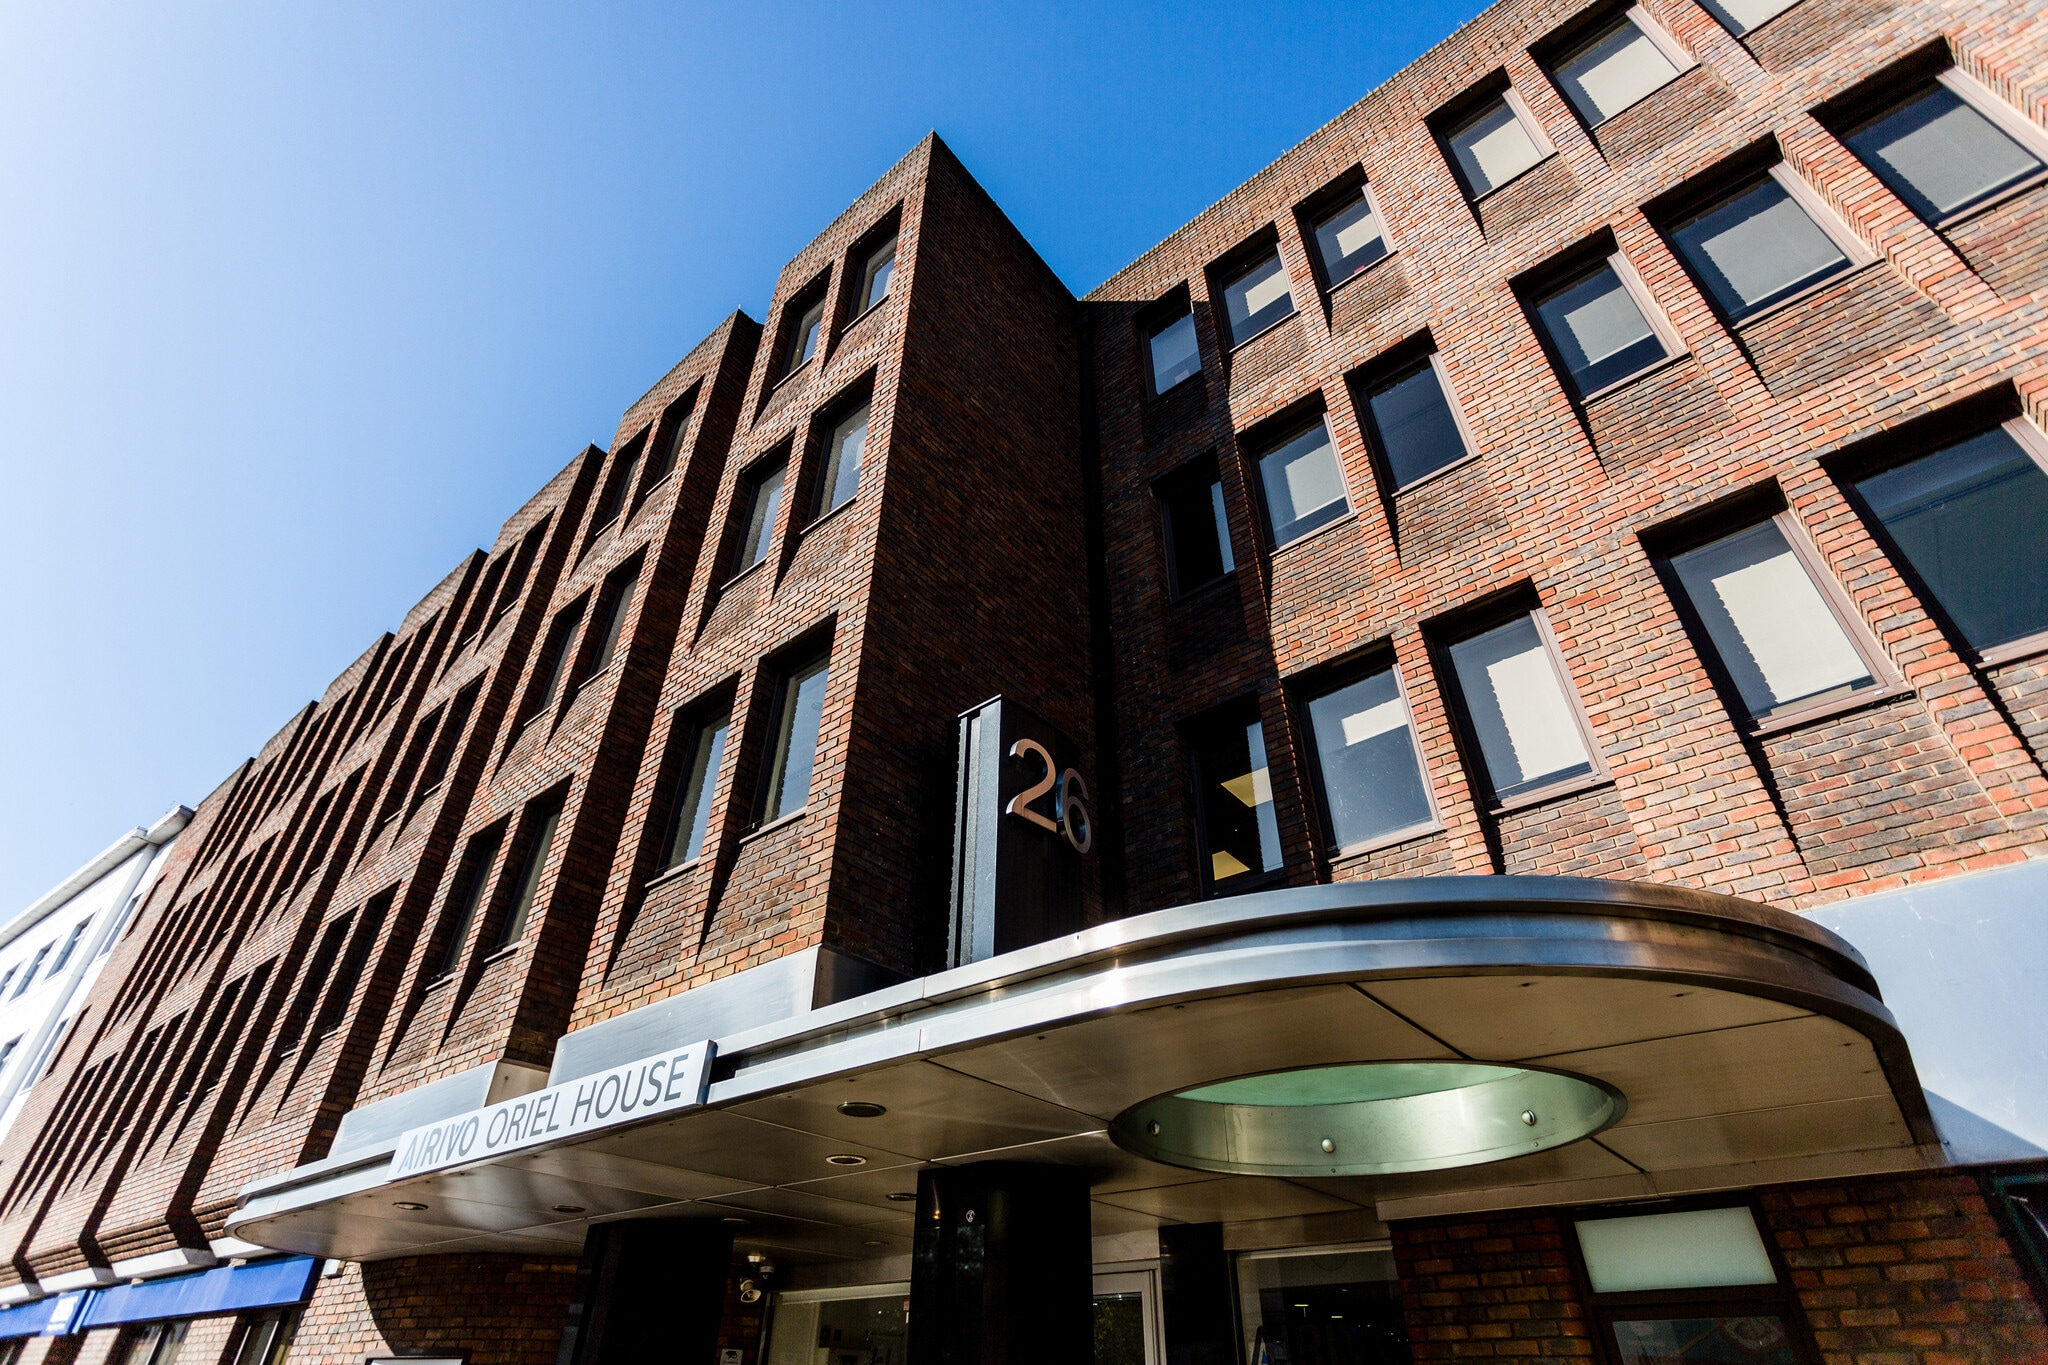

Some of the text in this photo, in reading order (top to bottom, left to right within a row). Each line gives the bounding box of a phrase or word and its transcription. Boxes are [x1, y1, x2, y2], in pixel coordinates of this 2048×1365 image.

[1006, 738, 1092, 853] 26
[398, 1054, 690, 1174] AIRIVO ORIEL HOUSE
